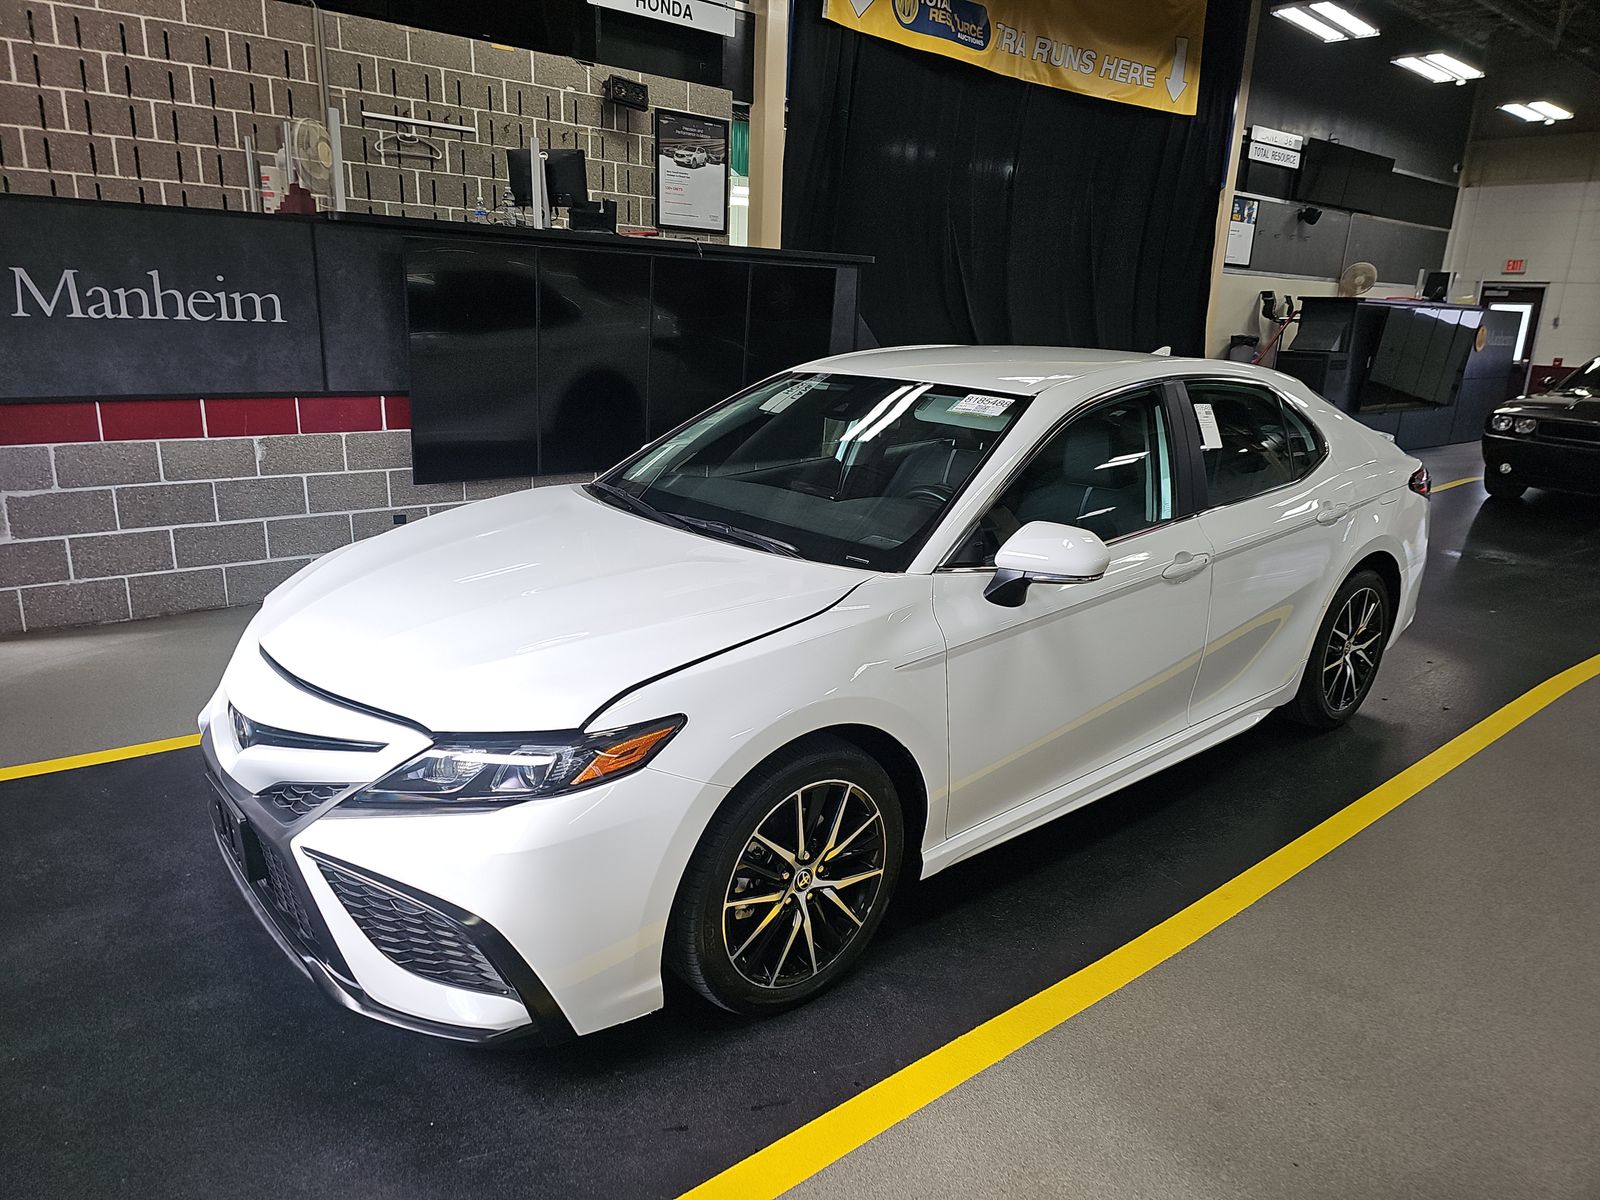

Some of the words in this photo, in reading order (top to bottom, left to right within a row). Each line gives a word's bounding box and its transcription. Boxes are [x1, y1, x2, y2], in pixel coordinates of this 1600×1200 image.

[636, 0, 693, 21] HONDA
[1032, 36, 1098, 75] RUNS
[1099, 54, 1157, 88] HERE
[1254, 146, 1269, 159] TOTAL
[1271, 150, 1297, 165] RESOURCE
[1506, 259, 1524, 271] EXIT
[8, 266, 288, 323] Manheim
[965, 395, 1012, 407] 8185488
